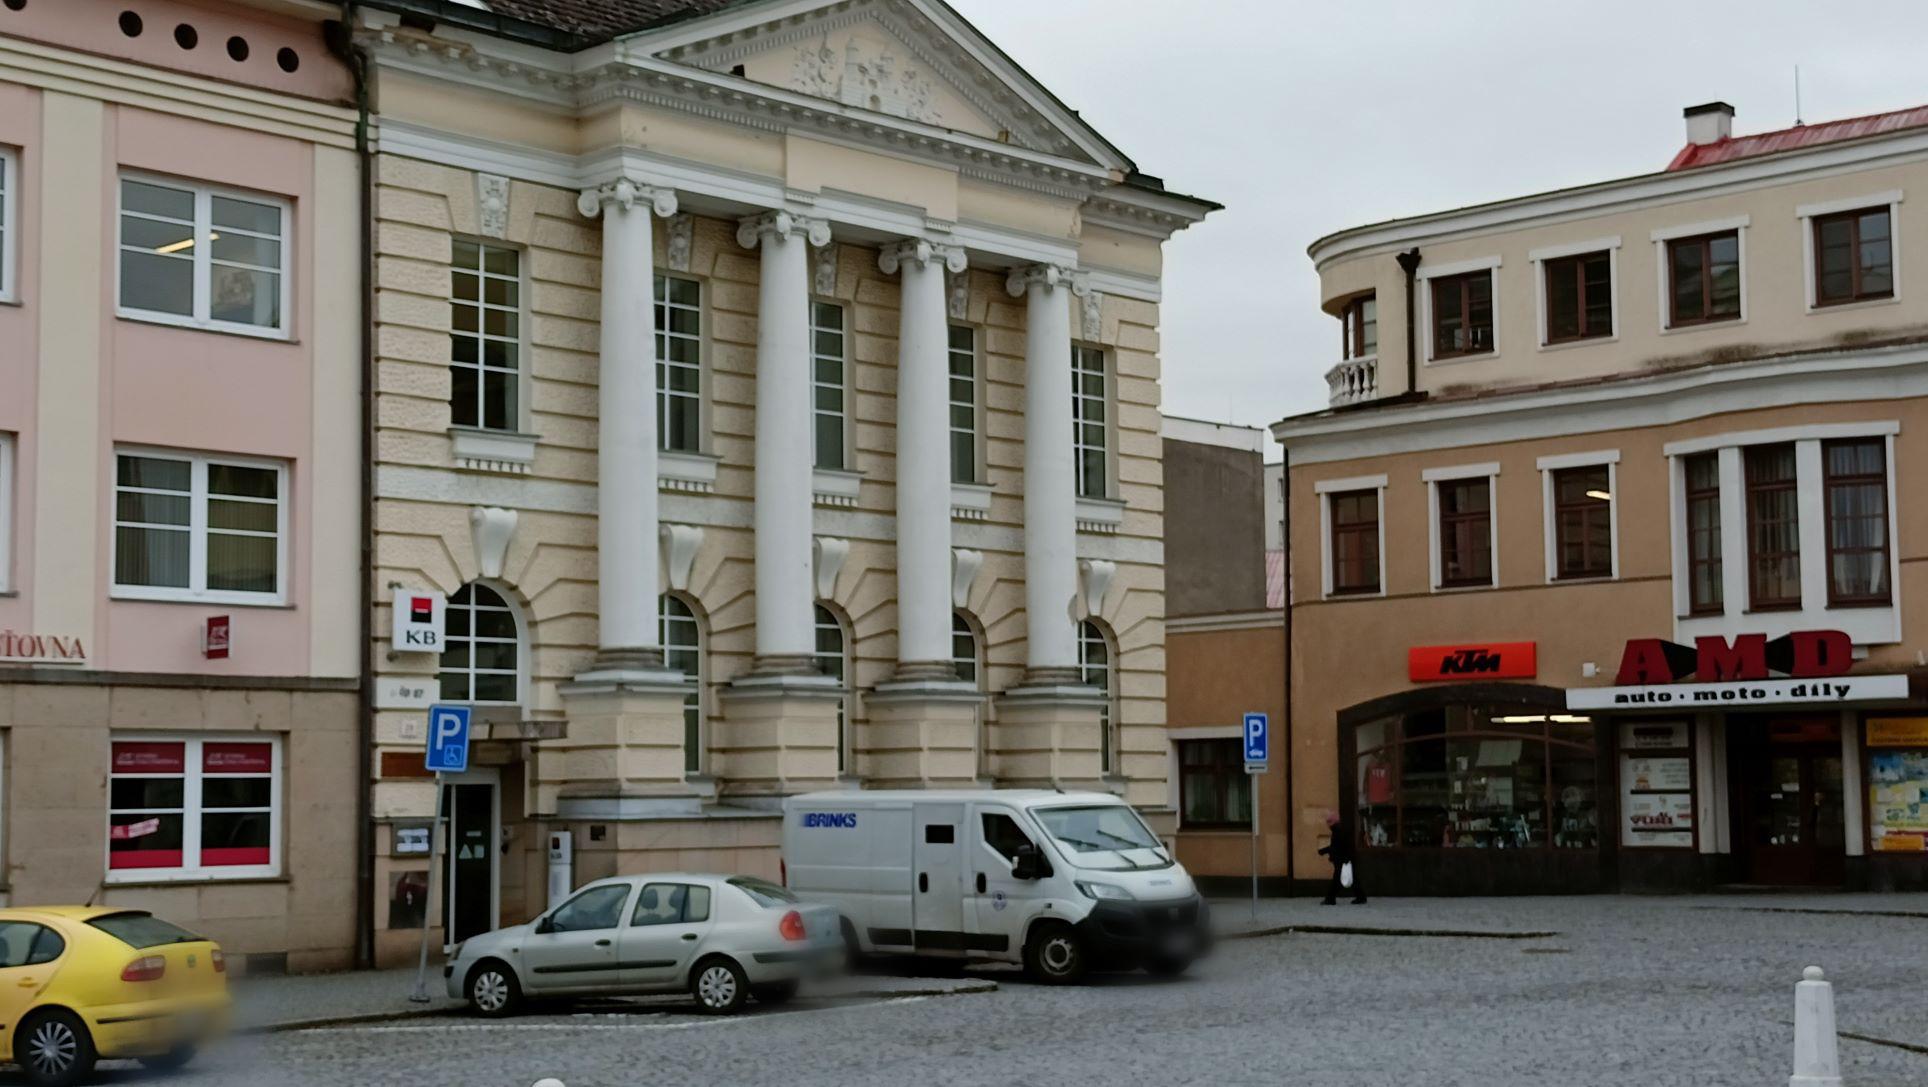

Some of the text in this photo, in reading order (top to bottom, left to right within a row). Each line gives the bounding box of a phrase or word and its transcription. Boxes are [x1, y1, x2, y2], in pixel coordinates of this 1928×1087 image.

[0, 629, 86, 659] ŤOVNA
[406, 630, 436, 645] KB
[1440, 649, 1502, 674] KTM
[1614, 630, 1853, 686] AMD
[1614, 691, 1672, 704] auto
[1693, 687, 1767, 702] moto
[435, 713, 461, 750] P
[1249, 719, 1263, 747] P
[806, 813, 857, 828] BRINKS
